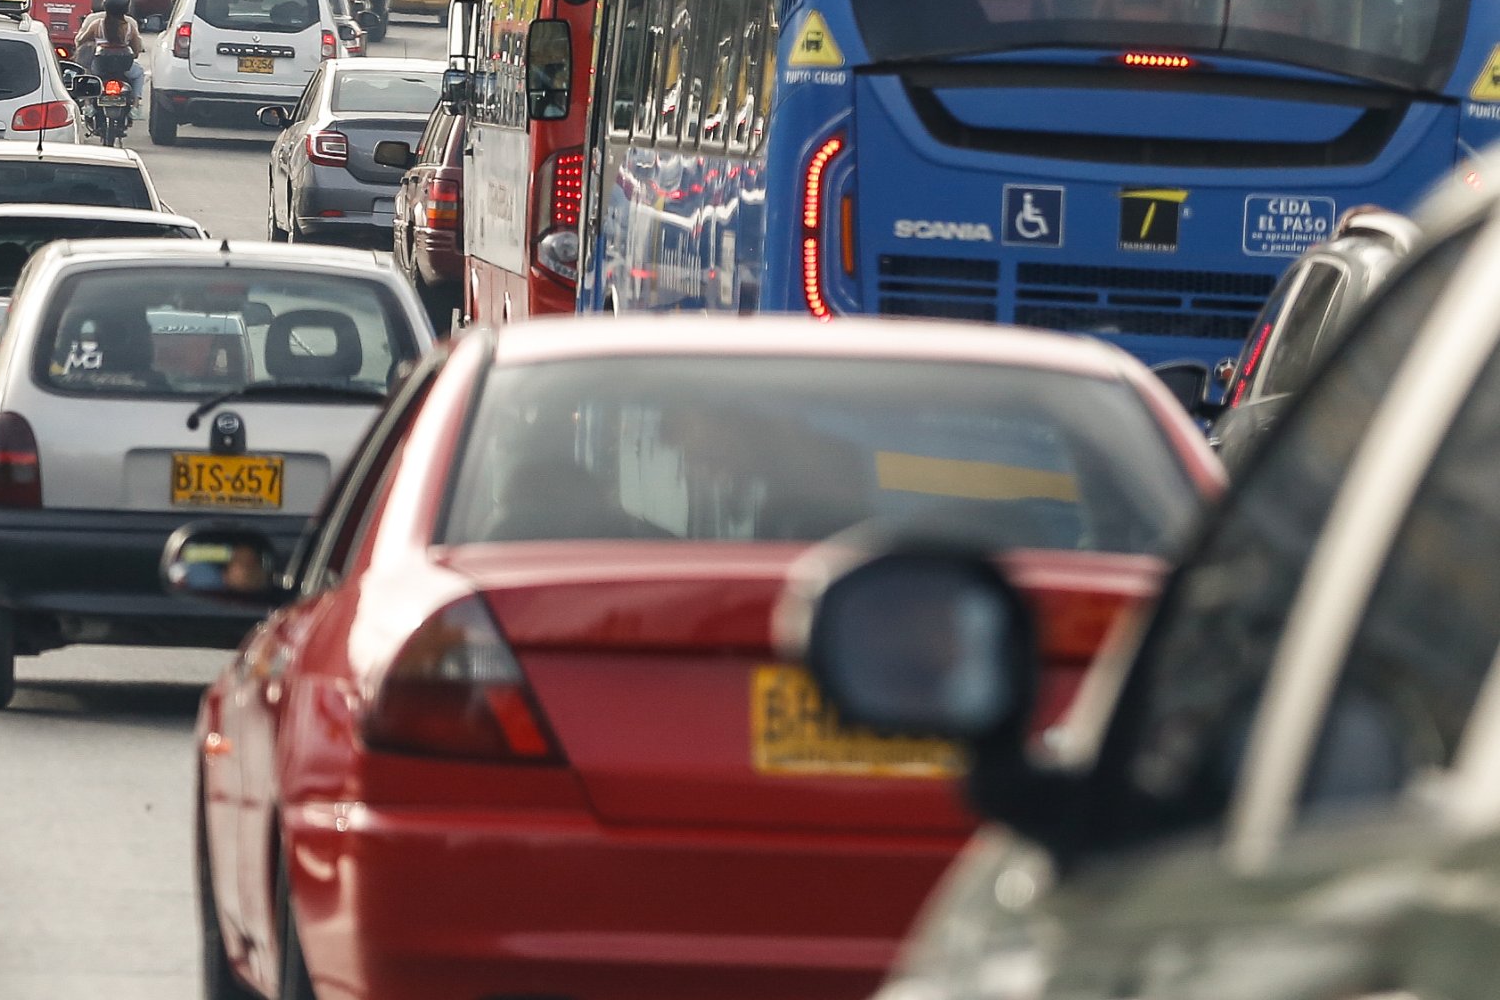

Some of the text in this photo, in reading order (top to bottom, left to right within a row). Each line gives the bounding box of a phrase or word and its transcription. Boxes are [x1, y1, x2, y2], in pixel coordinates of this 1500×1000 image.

[1268, 199, 1312, 215] CEDA
[894, 219, 993, 241] SCANIA
[1259, 216, 1328, 233] EL PASO
[175, 462, 281, 495] BIS-657
